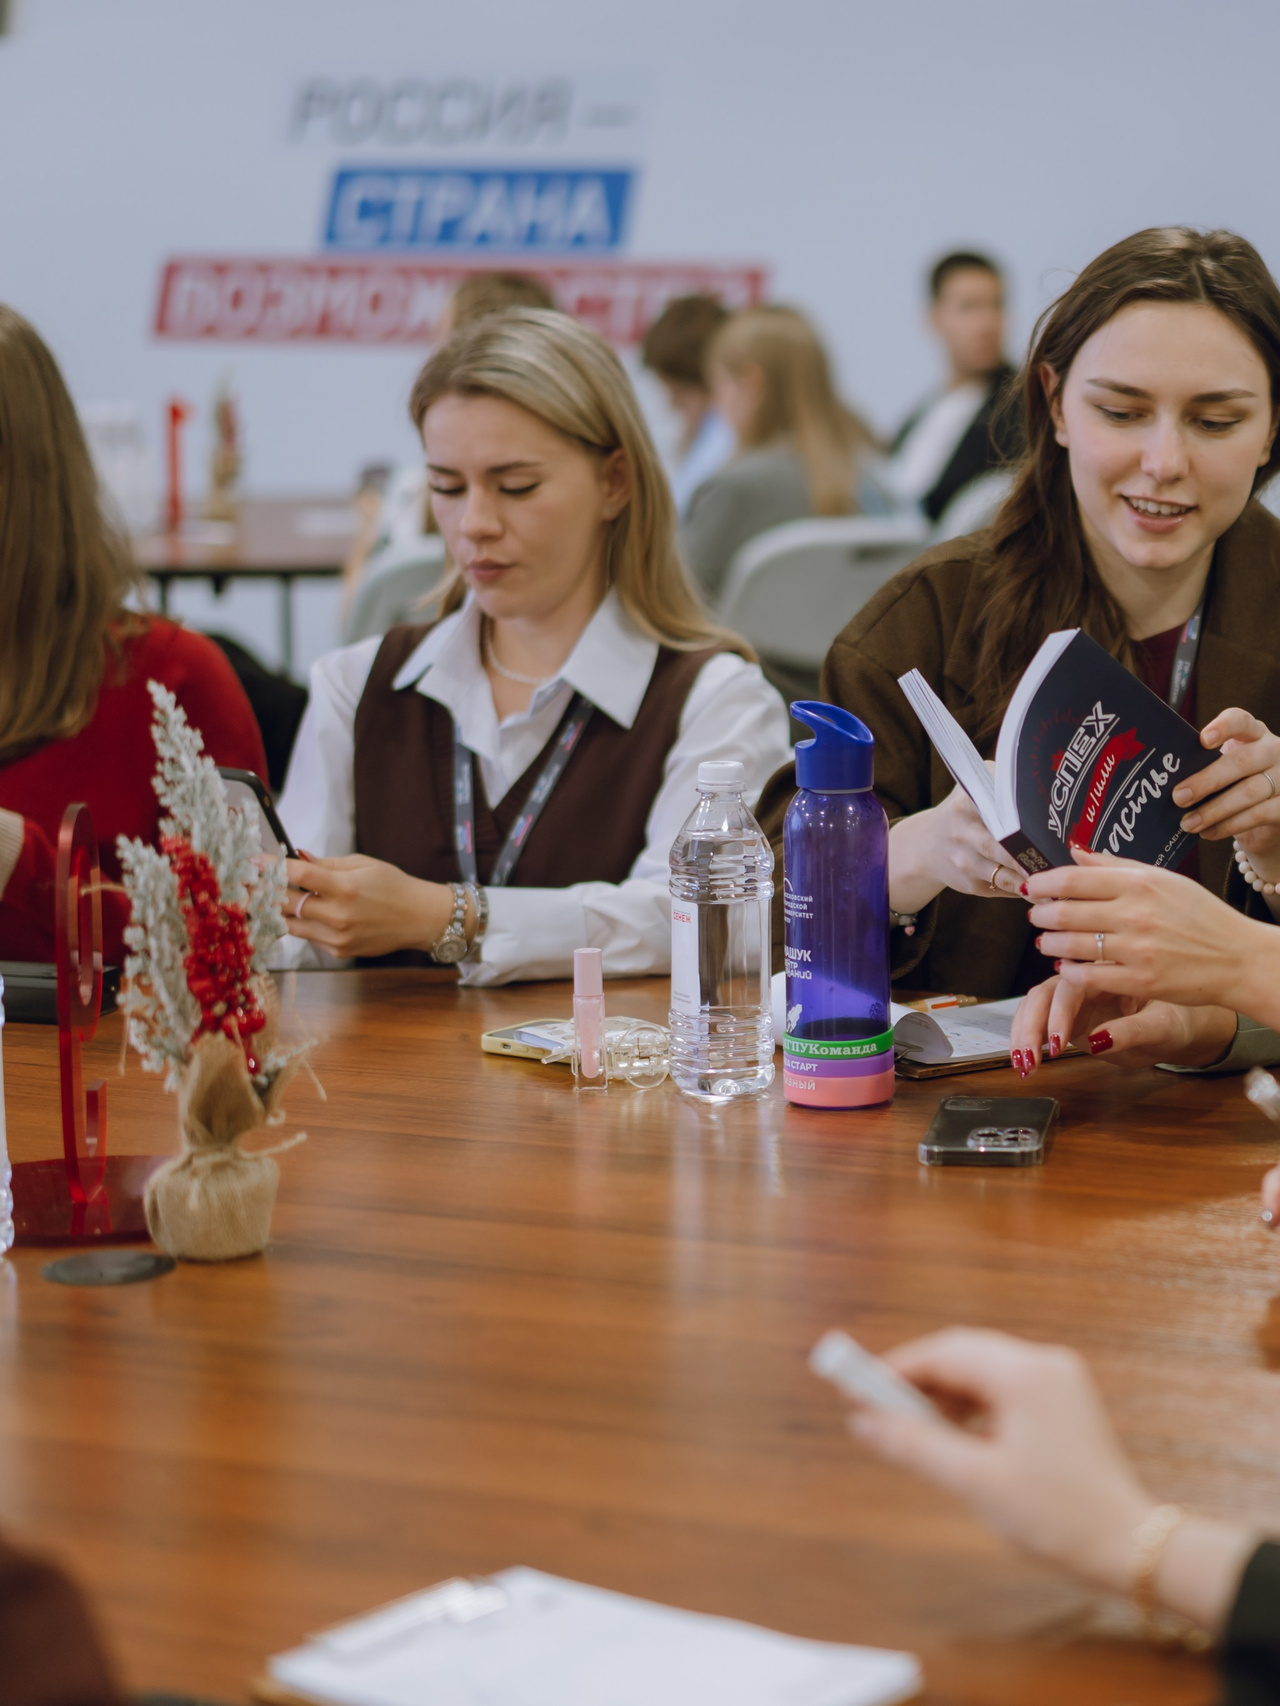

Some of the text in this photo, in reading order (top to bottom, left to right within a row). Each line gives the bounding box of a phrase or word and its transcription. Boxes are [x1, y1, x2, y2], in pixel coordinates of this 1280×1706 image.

[290, 77, 572, 147] РОССИЯ
[335, 175, 612, 245] СТРАНА
[1048, 700, 1117, 839] УСПЕХ
[785, 958, 799, 969] ЕНТР
[791, 1060, 818, 1072] СТАРТ
